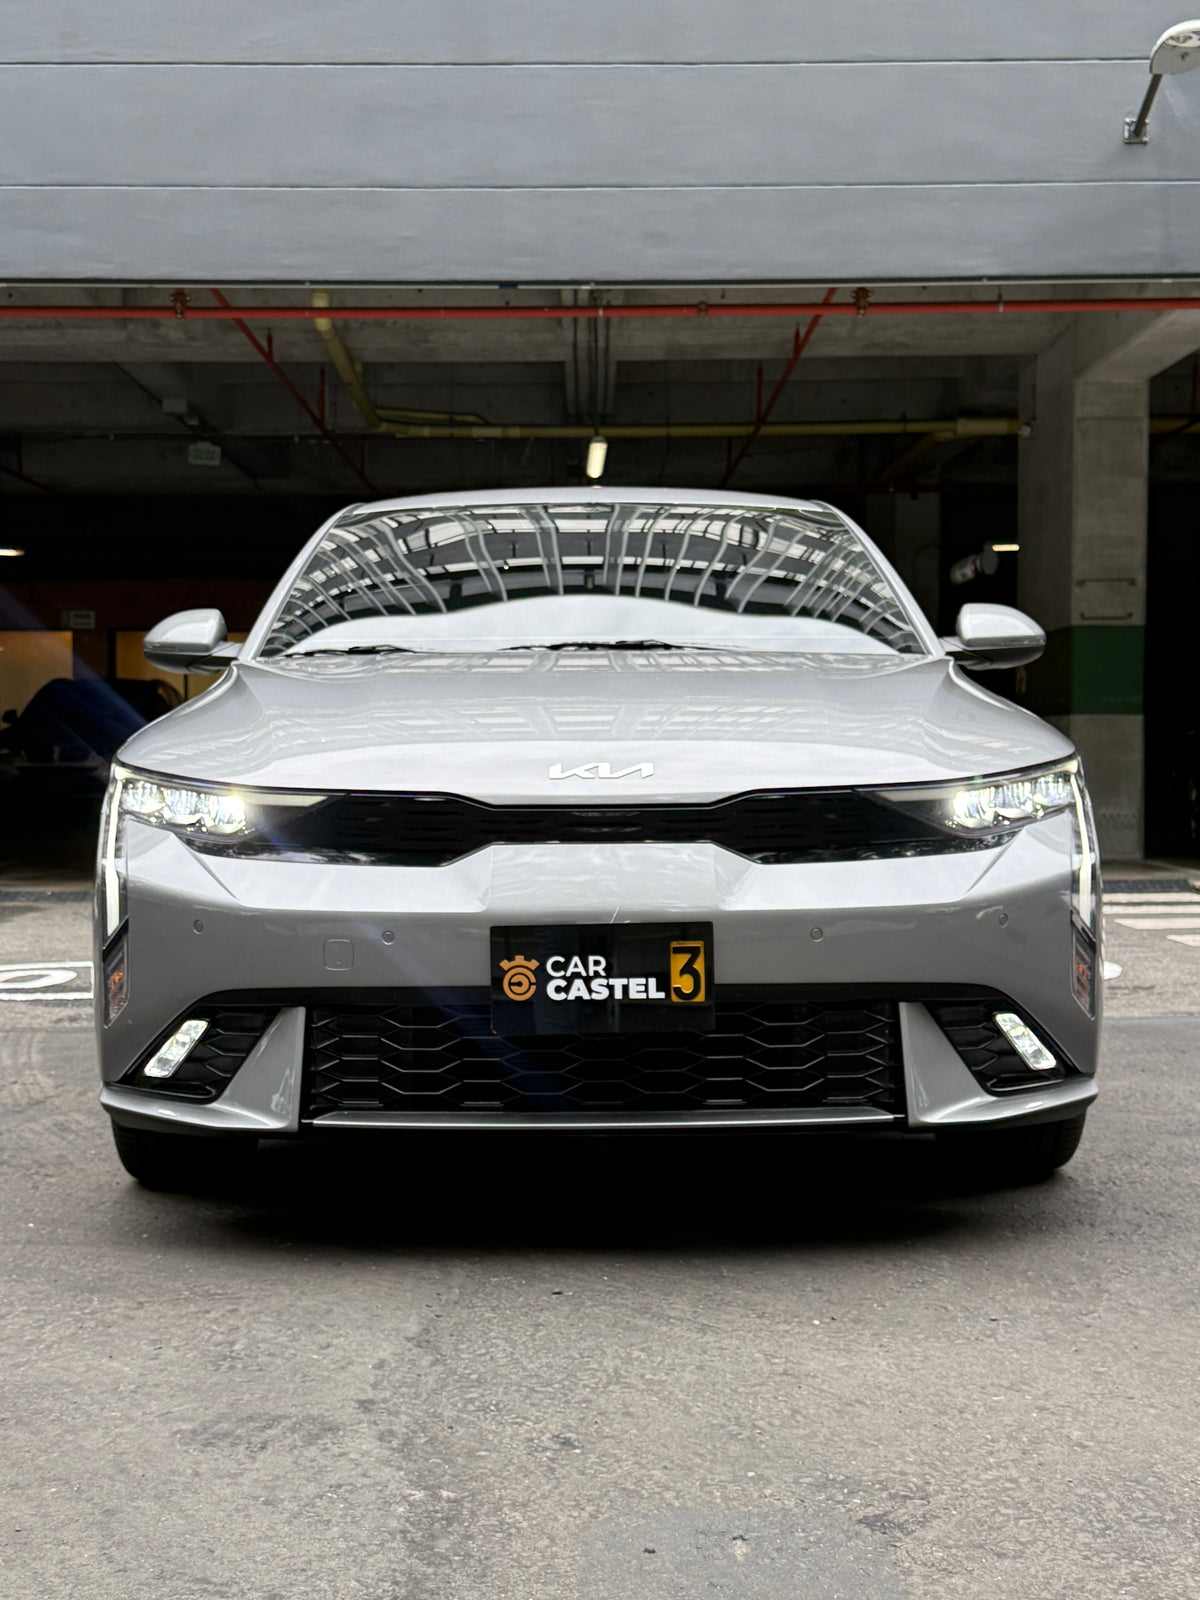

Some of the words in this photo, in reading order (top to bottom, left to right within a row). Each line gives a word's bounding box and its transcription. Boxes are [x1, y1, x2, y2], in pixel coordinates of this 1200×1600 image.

[546, 955, 607, 977] CAR
[672, 946, 702, 1001] 3
[546, 977, 666, 1001] CASTEL
